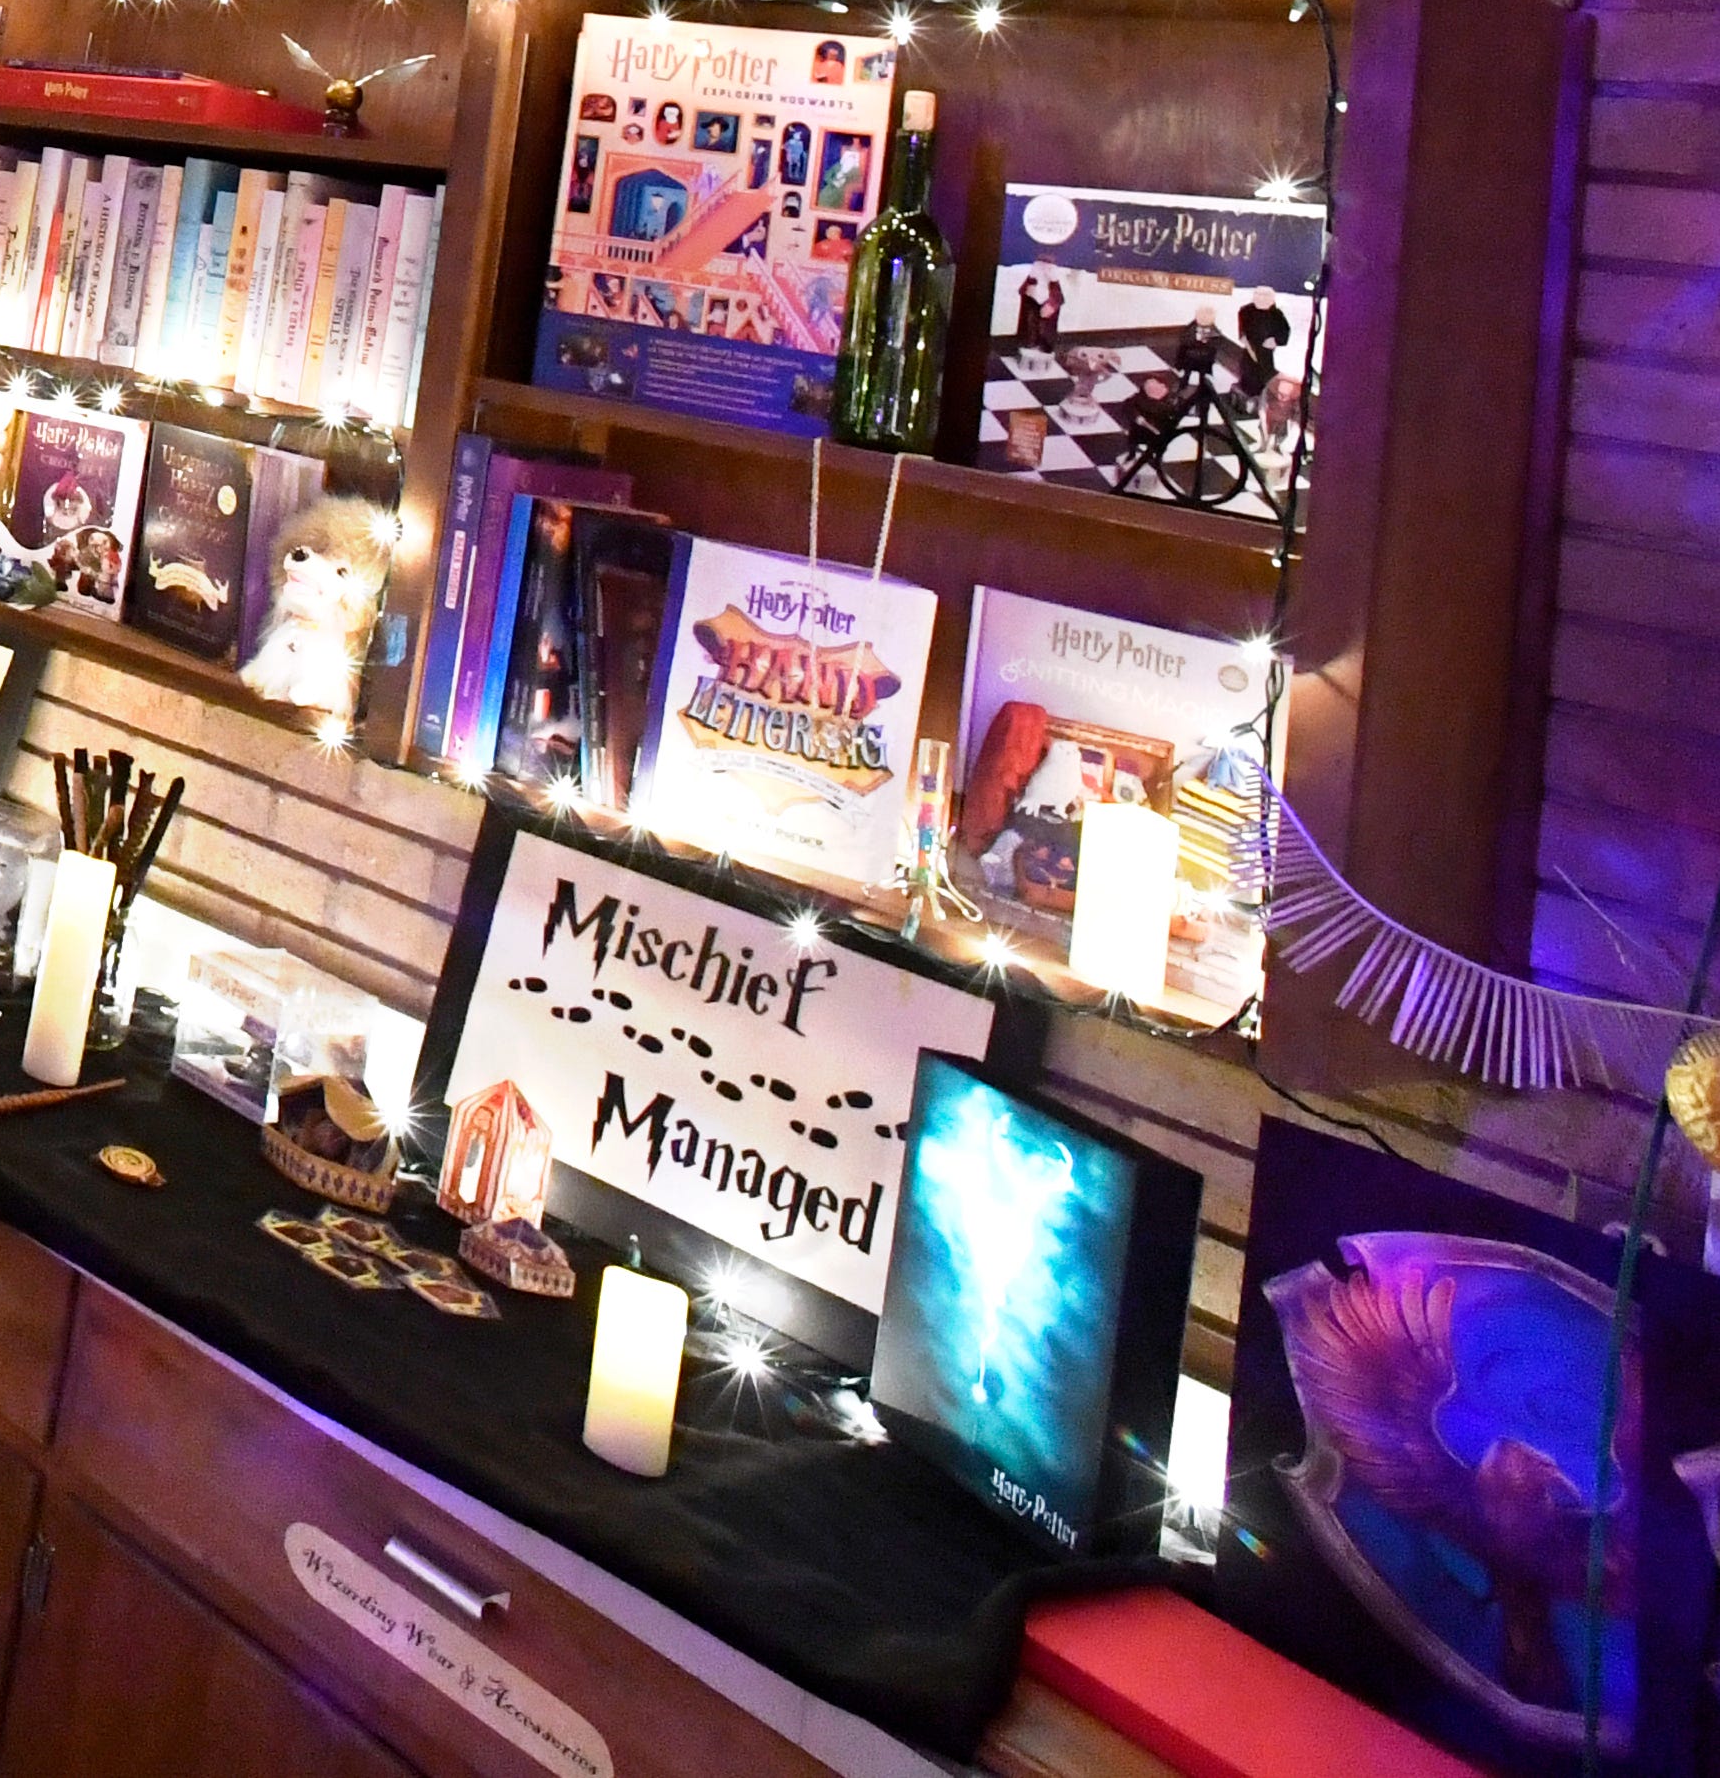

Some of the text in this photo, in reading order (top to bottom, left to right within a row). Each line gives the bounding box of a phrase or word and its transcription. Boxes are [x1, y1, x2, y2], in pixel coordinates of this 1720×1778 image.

[607, 37, 778, 92] Harry Potter
[702, 87, 855, 111] EXPLORING HOGWARTS
[103, 194, 111, 203] A
[133, 201, 148, 247] POTIONS
[95, 206, 109, 259] HISTORY
[1091, 212, 1170, 258] Harry
[1172, 212, 1257, 261] Potter
[1174, 274, 1232, 293] CHESS
[329, 296, 343, 345] SPELLS
[33, 421, 120, 457] Harry Potter
[745, 585, 800, 622] Harry
[798, 591, 856, 635] Potter
[1047, 621, 1114, 663] Harry
[1116, 630, 1187, 679] Potter
[717, 637, 878, 721] HAND
[542, 877, 838, 1037] Mischief
[591, 1070, 885, 1255] Managed
[989, 1467, 1079, 1550] Harry Potter
[302, 1547, 599, 1776] Wizarding Wear & Accessories
